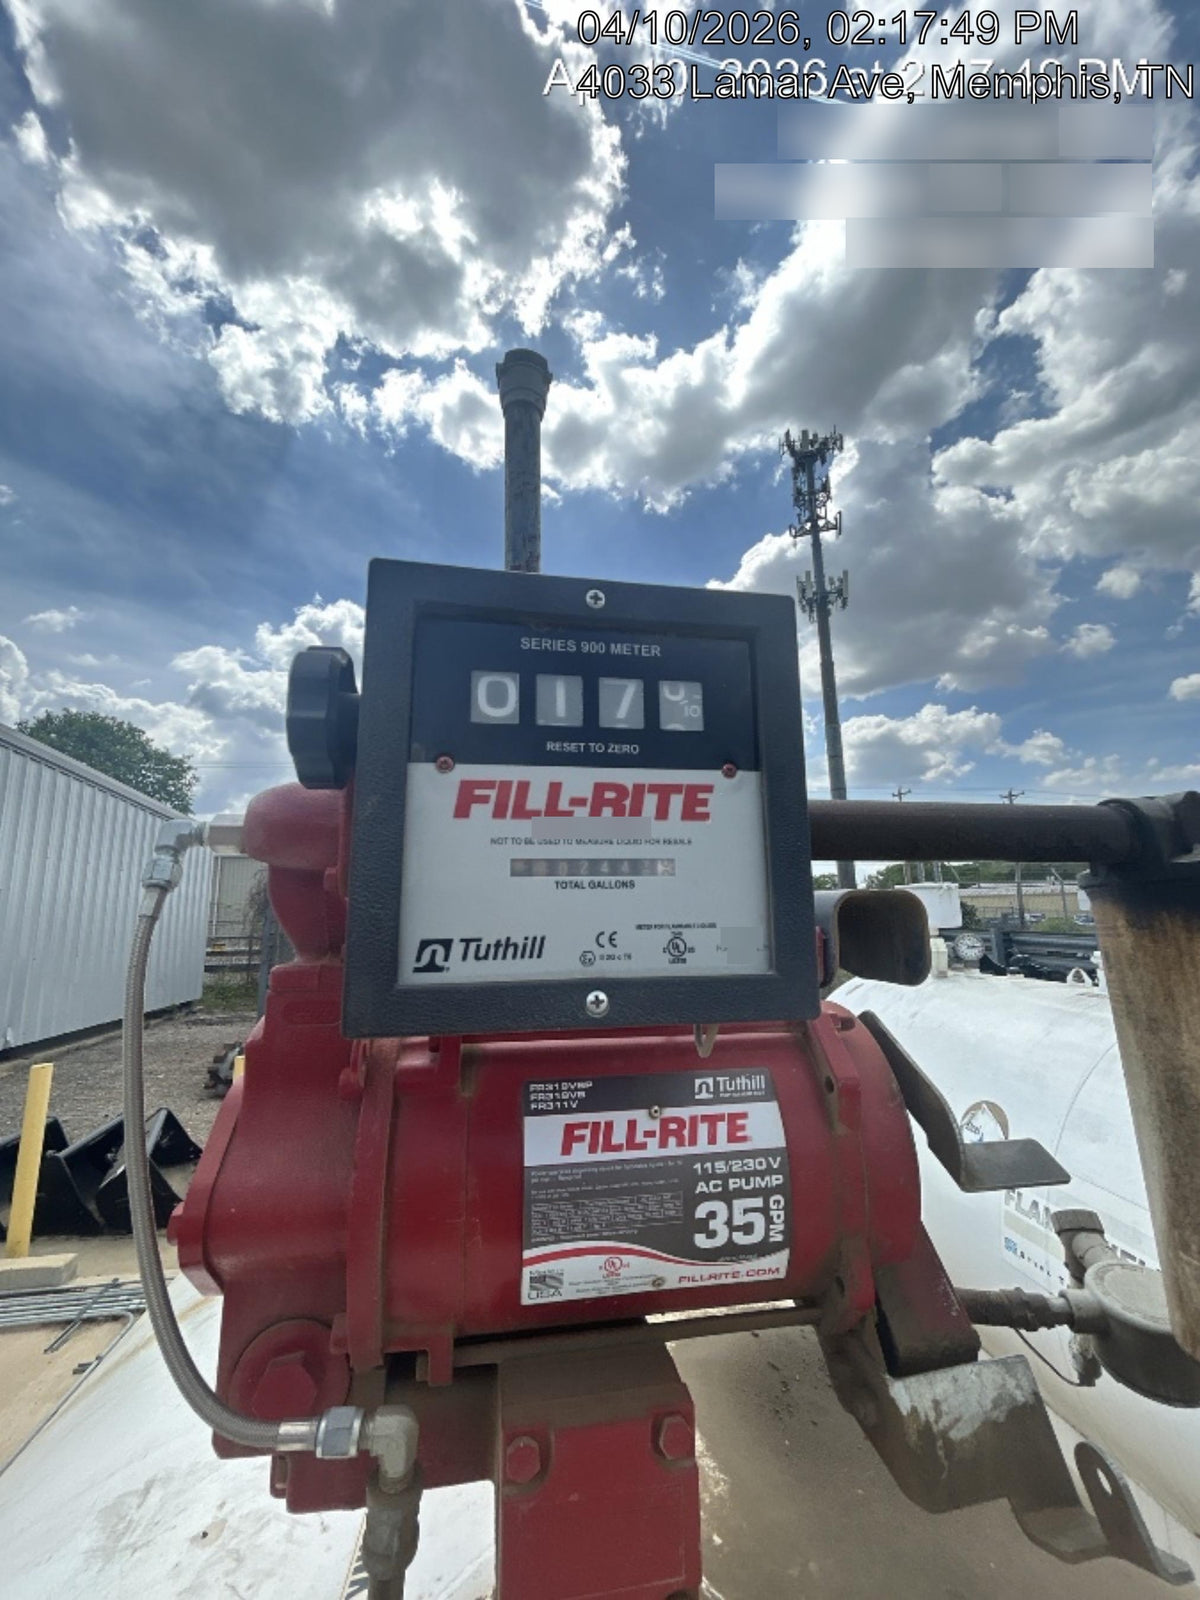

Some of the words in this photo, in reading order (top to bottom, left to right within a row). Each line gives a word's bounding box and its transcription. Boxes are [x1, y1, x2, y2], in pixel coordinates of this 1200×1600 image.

[520, 637, 577, 652] SERIES
[581, 641, 606, 654] 900
[610, 643, 662, 657] METER
[546, 741, 585, 754] RESET
[589, 742, 606, 754] TO
[608, 742, 640, 755] ZERO
[452, 779, 715, 822] FILL-RITE
[554, 880, 586, 891] TOTAL
[588, 880, 636, 890] GALLONS
[459, 935, 546, 962] Tuthill
[716, 1074, 766, 1092] Tuthill
[560, 1112, 749, 1156] FILL-RITE
[693, 1159, 766, 1175] 115/230
[768, 1157, 782, 1170] V
[695, 1180, 723, 1194] AC
[728, 1175, 784, 1192] PUMP
[693, 1197, 767, 1249] 35
[769, 1194, 785, 1243] GPM
[678, 1267, 780, 1284] FILLRITE.COM
